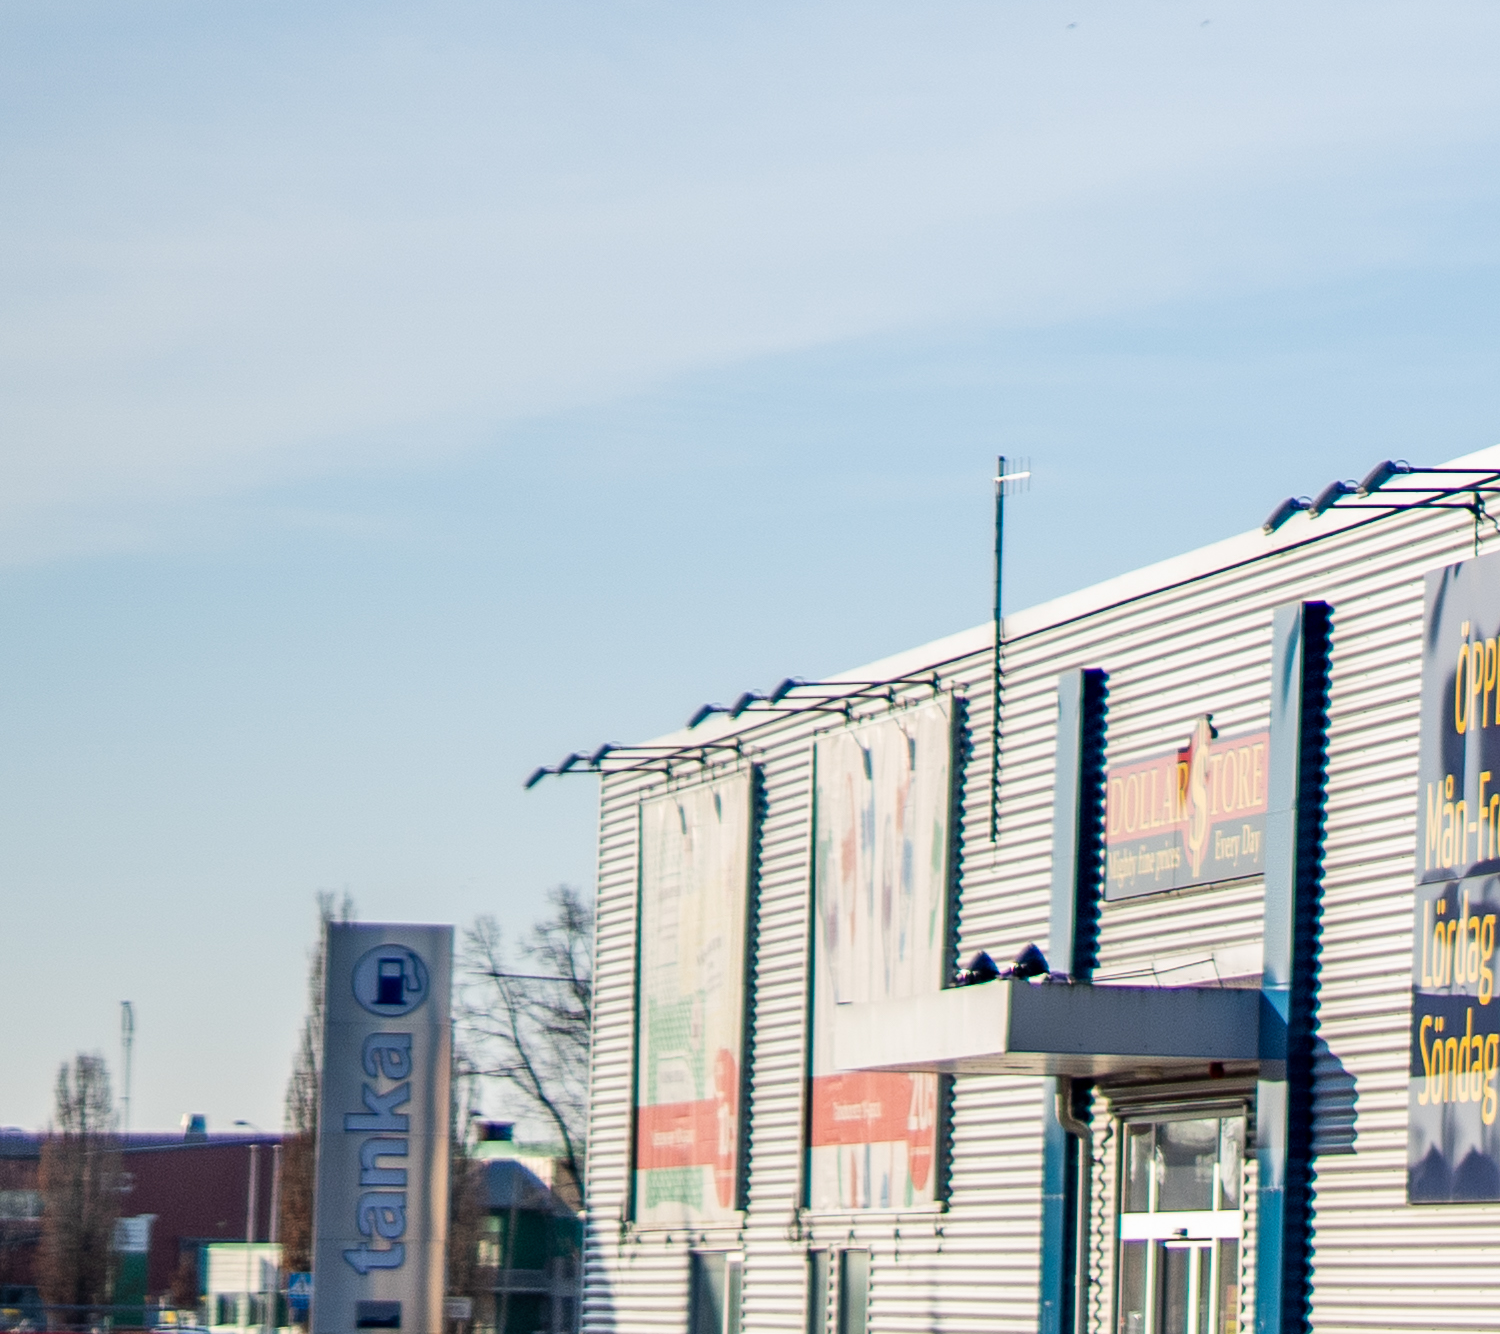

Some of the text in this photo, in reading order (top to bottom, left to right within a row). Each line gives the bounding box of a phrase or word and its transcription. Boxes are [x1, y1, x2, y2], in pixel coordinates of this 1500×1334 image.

[1109, 761, 1190, 836] DOLLAR
[1137, 844, 1155, 875] fine
[1155, 840, 1181, 881] prices
[1214, 830, 1240, 867] Every
[1242, 824, 1262, 863] Day
[1421, 889, 1496, 1005] Lördag
[1418, 1007, 1499, 1125] Söndag
[343, 1031, 412, 1276] tanka
